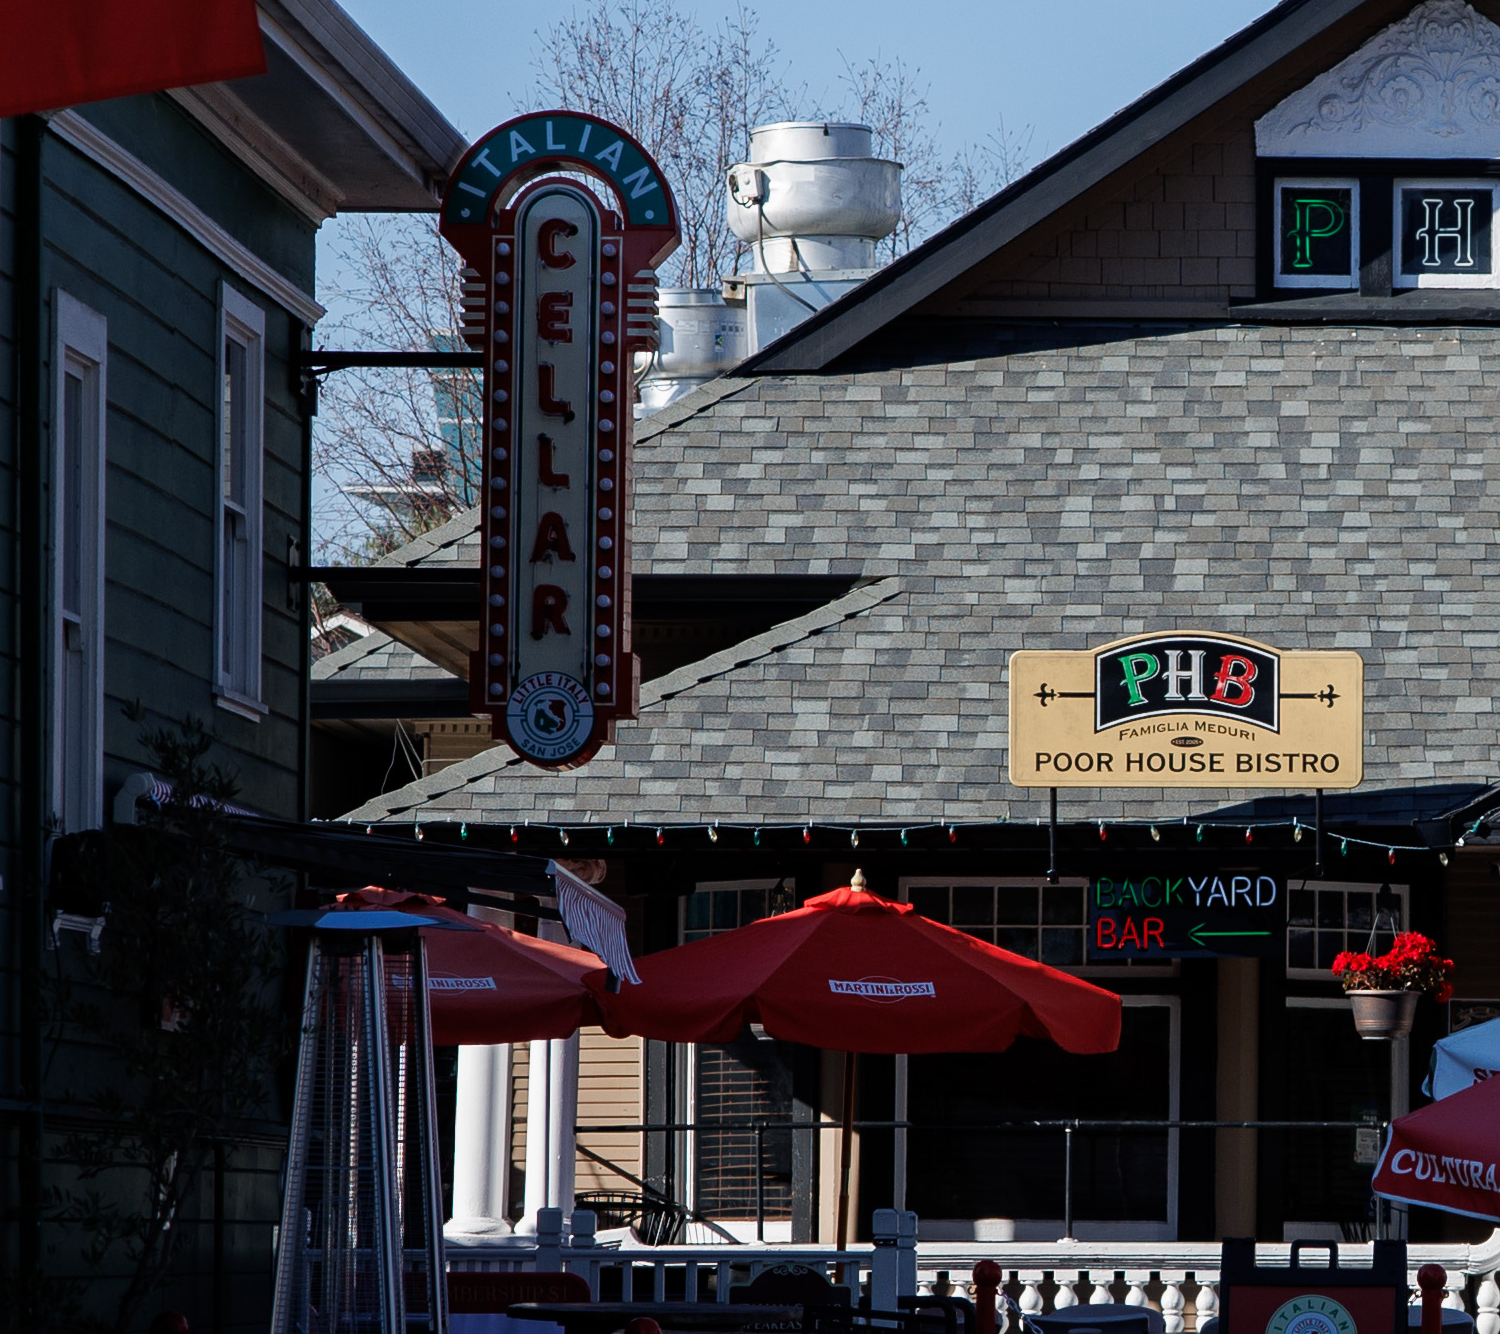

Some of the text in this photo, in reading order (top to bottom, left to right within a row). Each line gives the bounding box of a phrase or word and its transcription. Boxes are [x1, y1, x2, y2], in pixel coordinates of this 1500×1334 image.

[458, 120, 658, 199] ITALIAN
[529, 218, 578, 640] CELLAR
[512, 674, 589, 704] LITTLE ITALY
[1117, 650, 1259, 708] PHB
[521, 738, 580, 757] SAN JOSE
[1119, 721, 1255, 742] FAMIGLIA MEDURI
[1035, 753, 1339, 774] POOR HOUSE BISTRO
[1095, 875, 1277, 908] BACKYARD
[1097, 917, 1165, 950] BAR
[1274, 1300, 1349, 1331] ITALIAN
